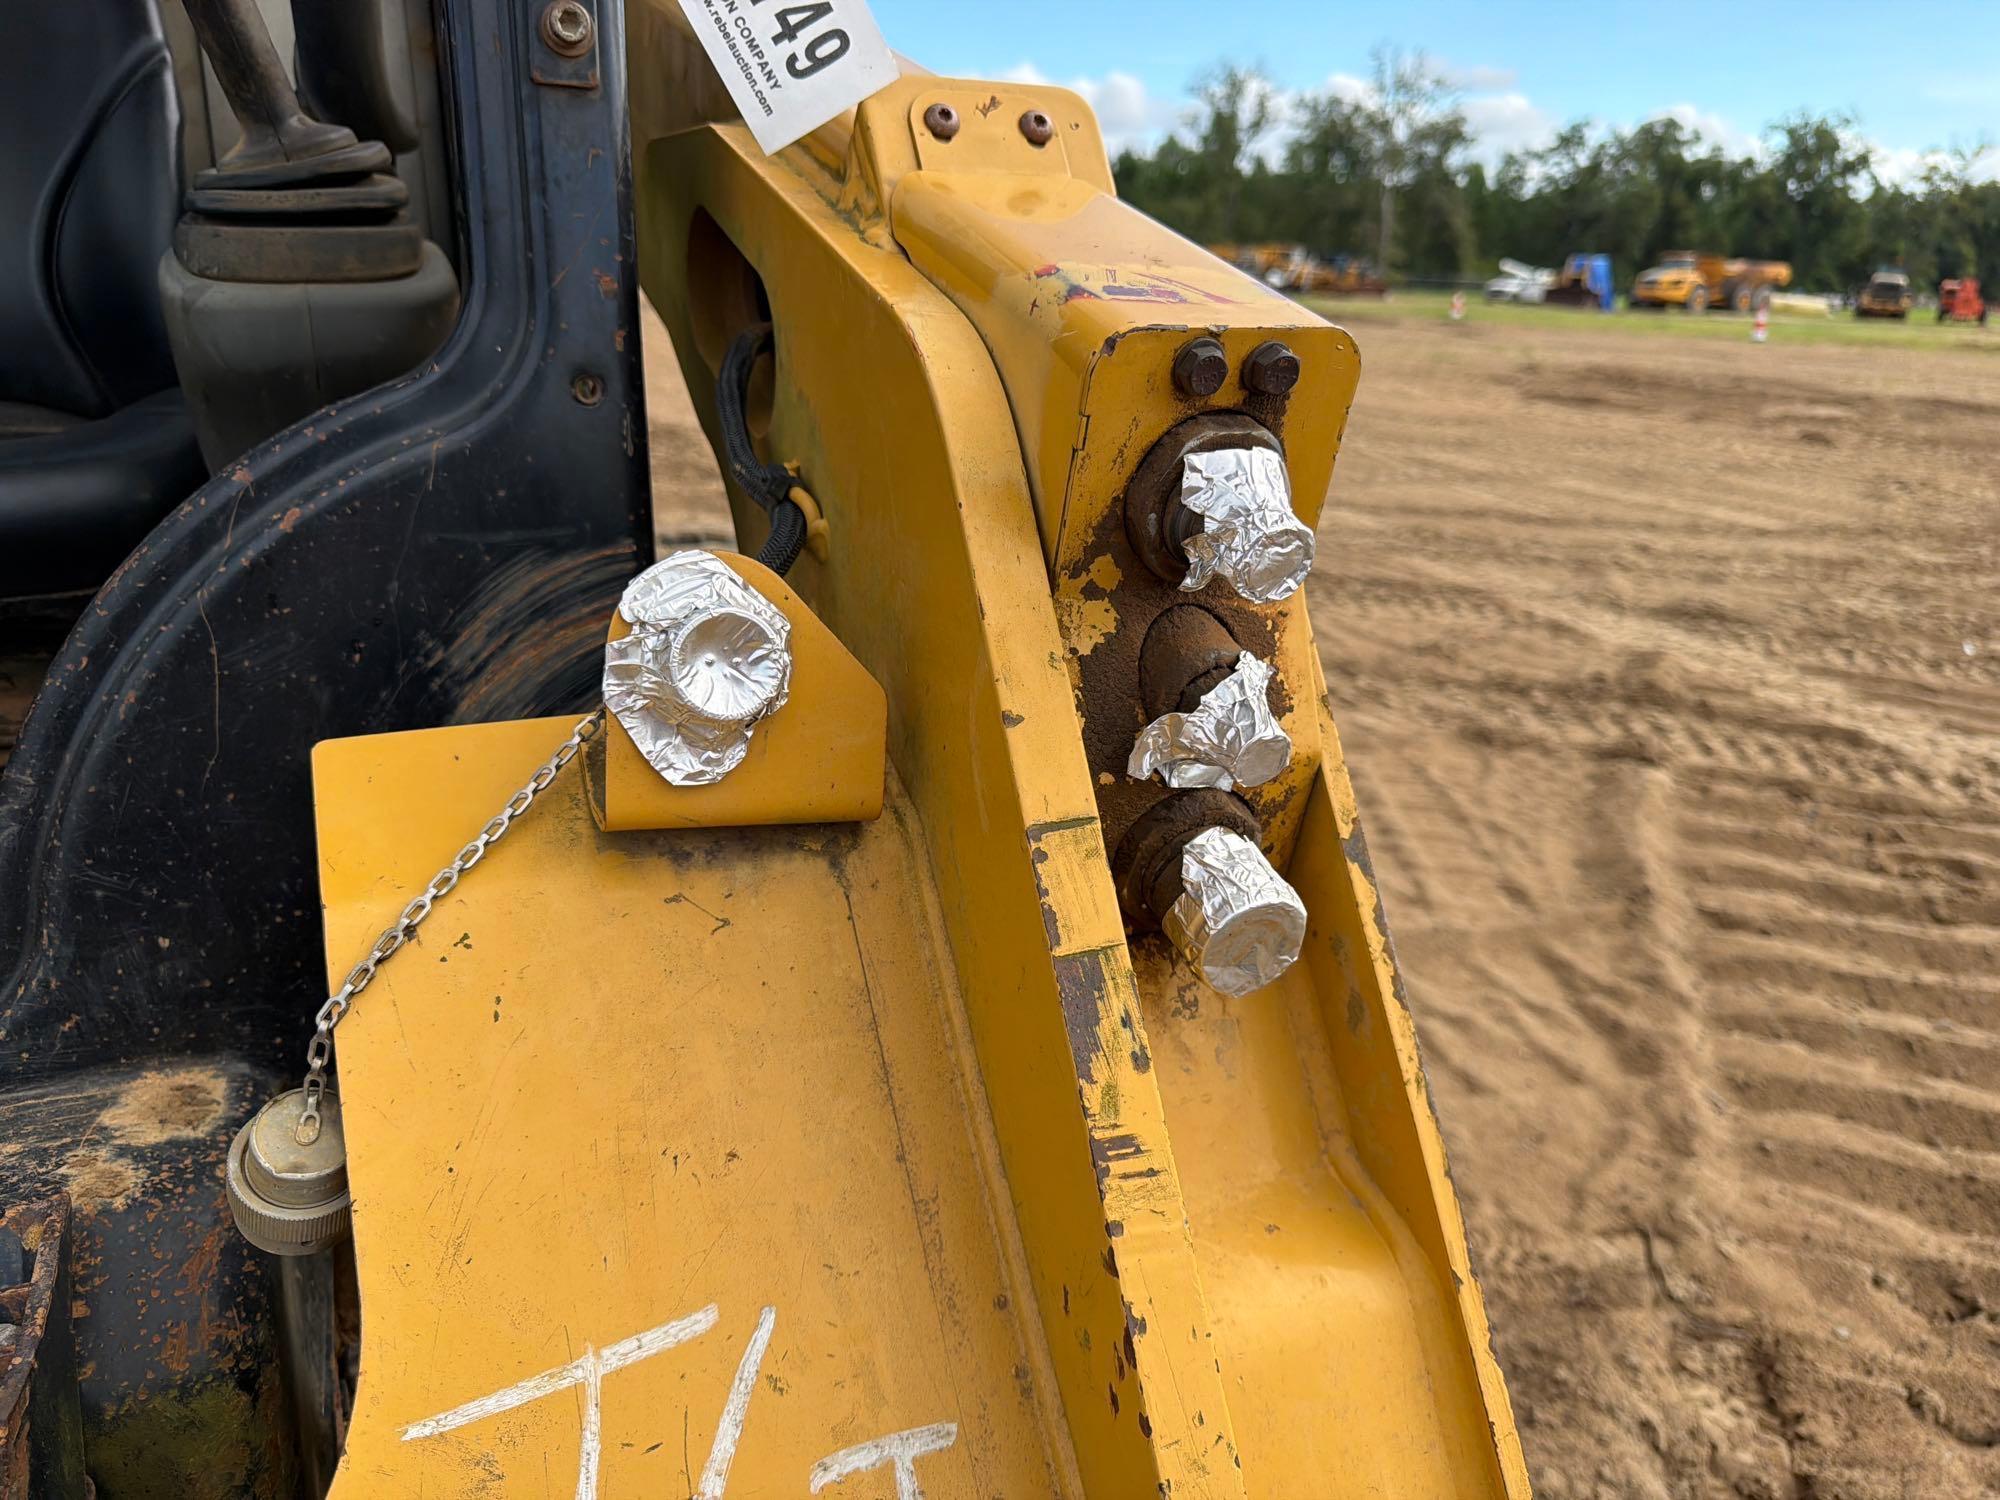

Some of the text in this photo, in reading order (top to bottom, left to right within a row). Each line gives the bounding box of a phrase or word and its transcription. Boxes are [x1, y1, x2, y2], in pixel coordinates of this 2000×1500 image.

[721, 0, 782, 90] N COMPANY
[750, 0, 850, 80] 49
